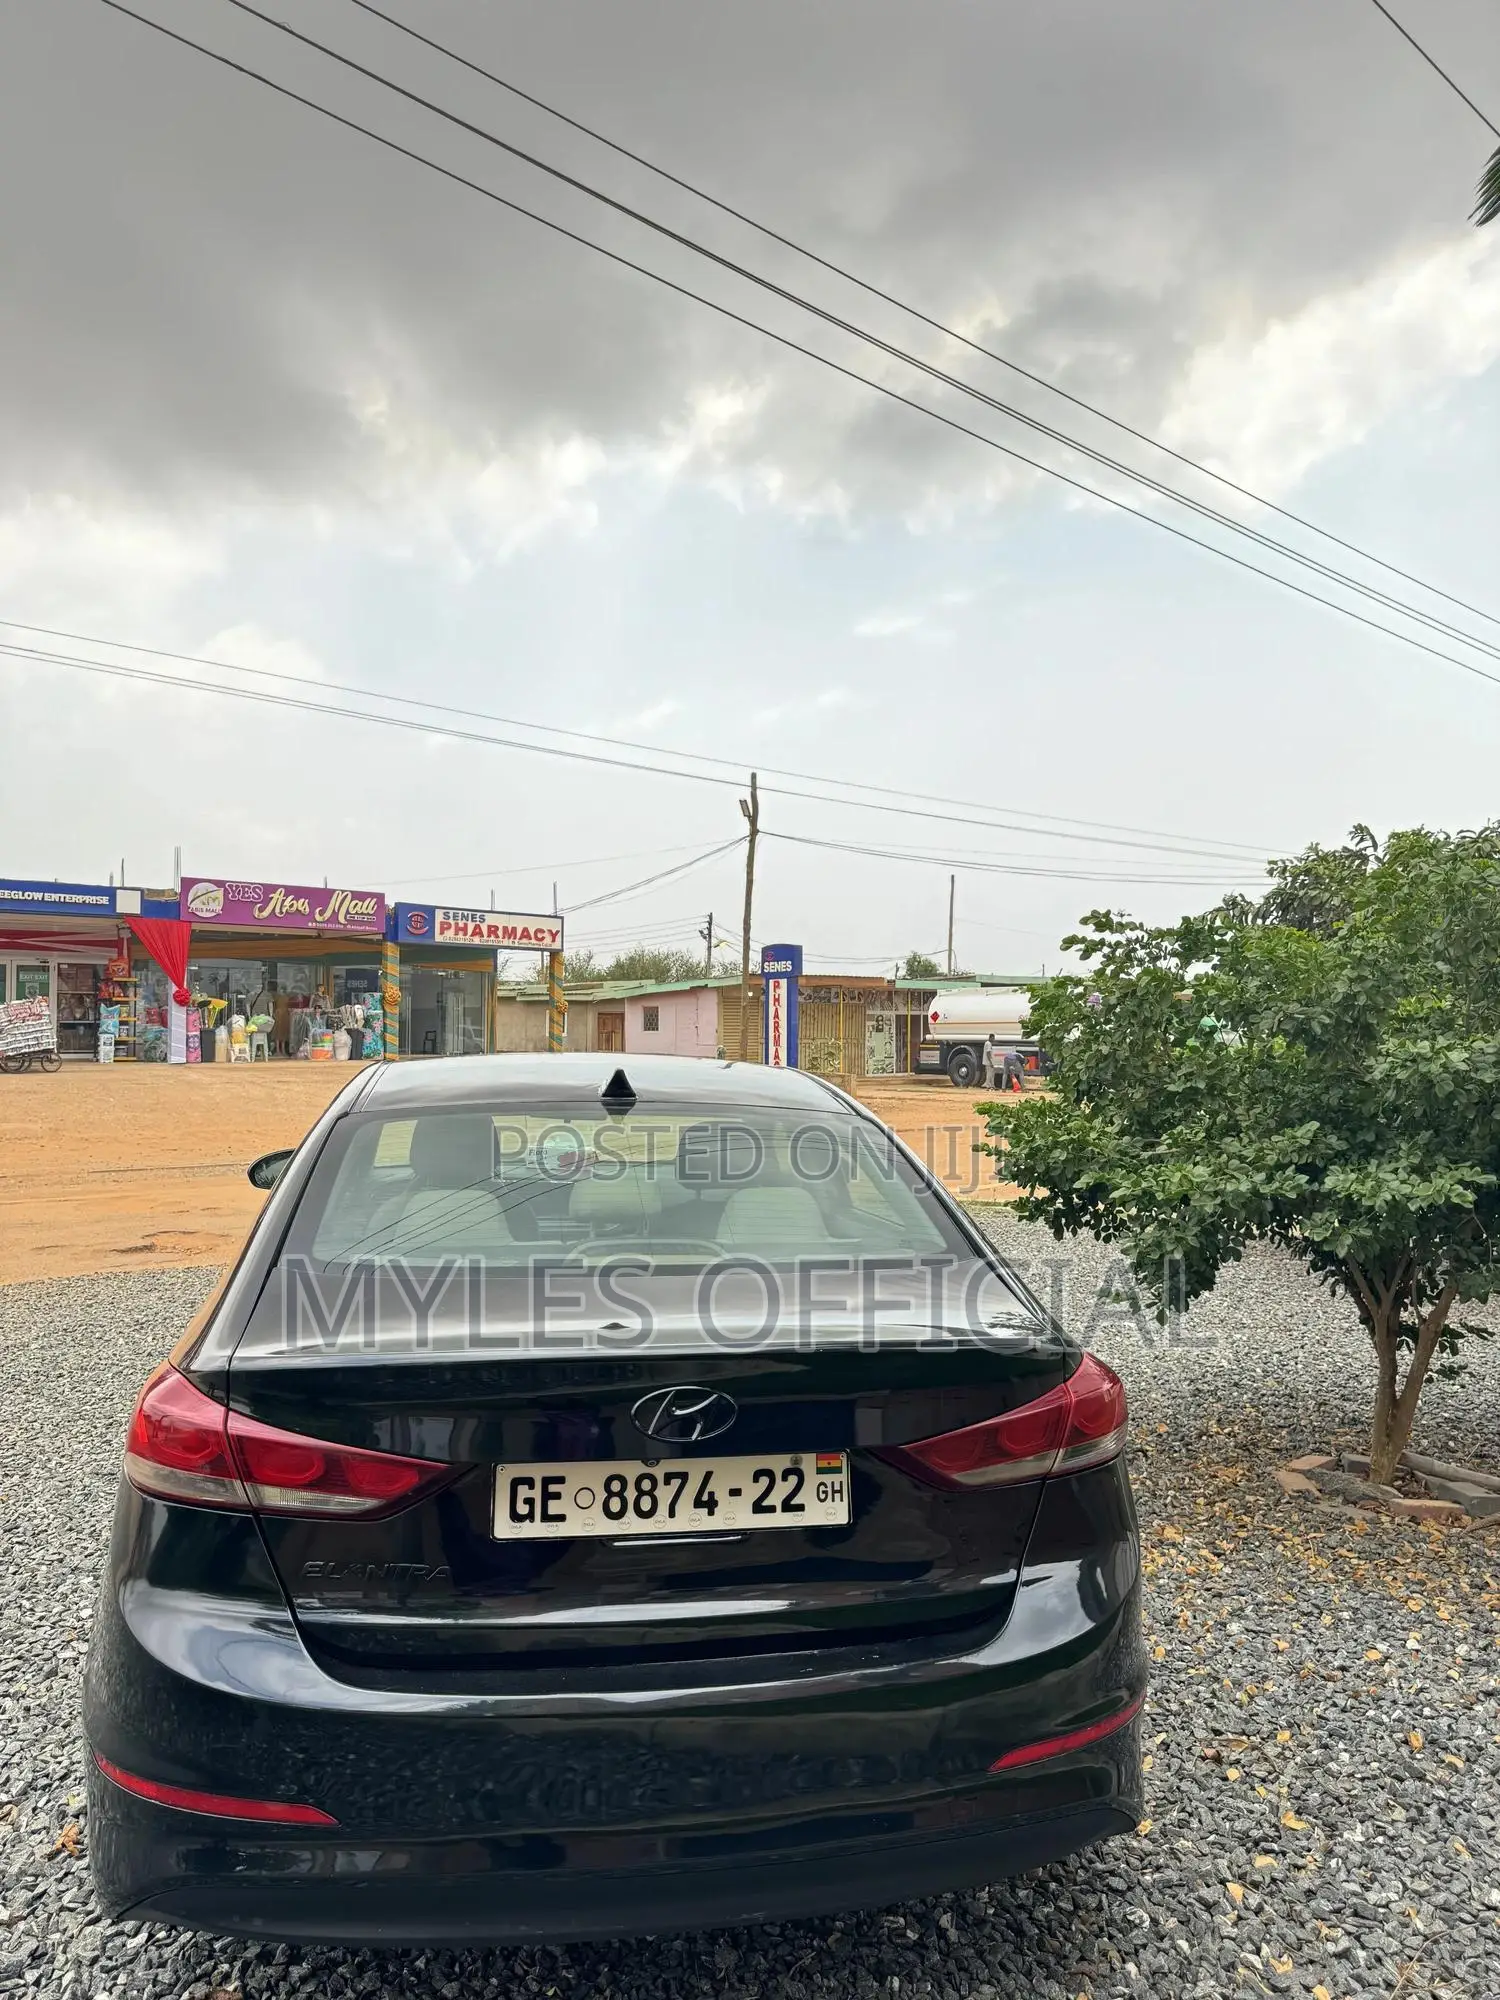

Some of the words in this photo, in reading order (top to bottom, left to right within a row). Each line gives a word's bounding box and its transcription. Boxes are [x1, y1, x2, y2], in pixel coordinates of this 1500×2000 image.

[44, 893, 109, 904] ENTERPRISE
[226, 883, 263, 901] YES
[315, 891, 377, 924] Mall
[443, 911, 486, 923] SENES
[439, 921, 560, 943] PHARMACY
[763, 961, 792, 972] SENES
[510, 1476, 566, 1523] GE
[602, 1467, 805, 1521] 8874-22
[816, 1480, 843, 1503] GH
[303, 1561, 450, 1581] ELANTRA
